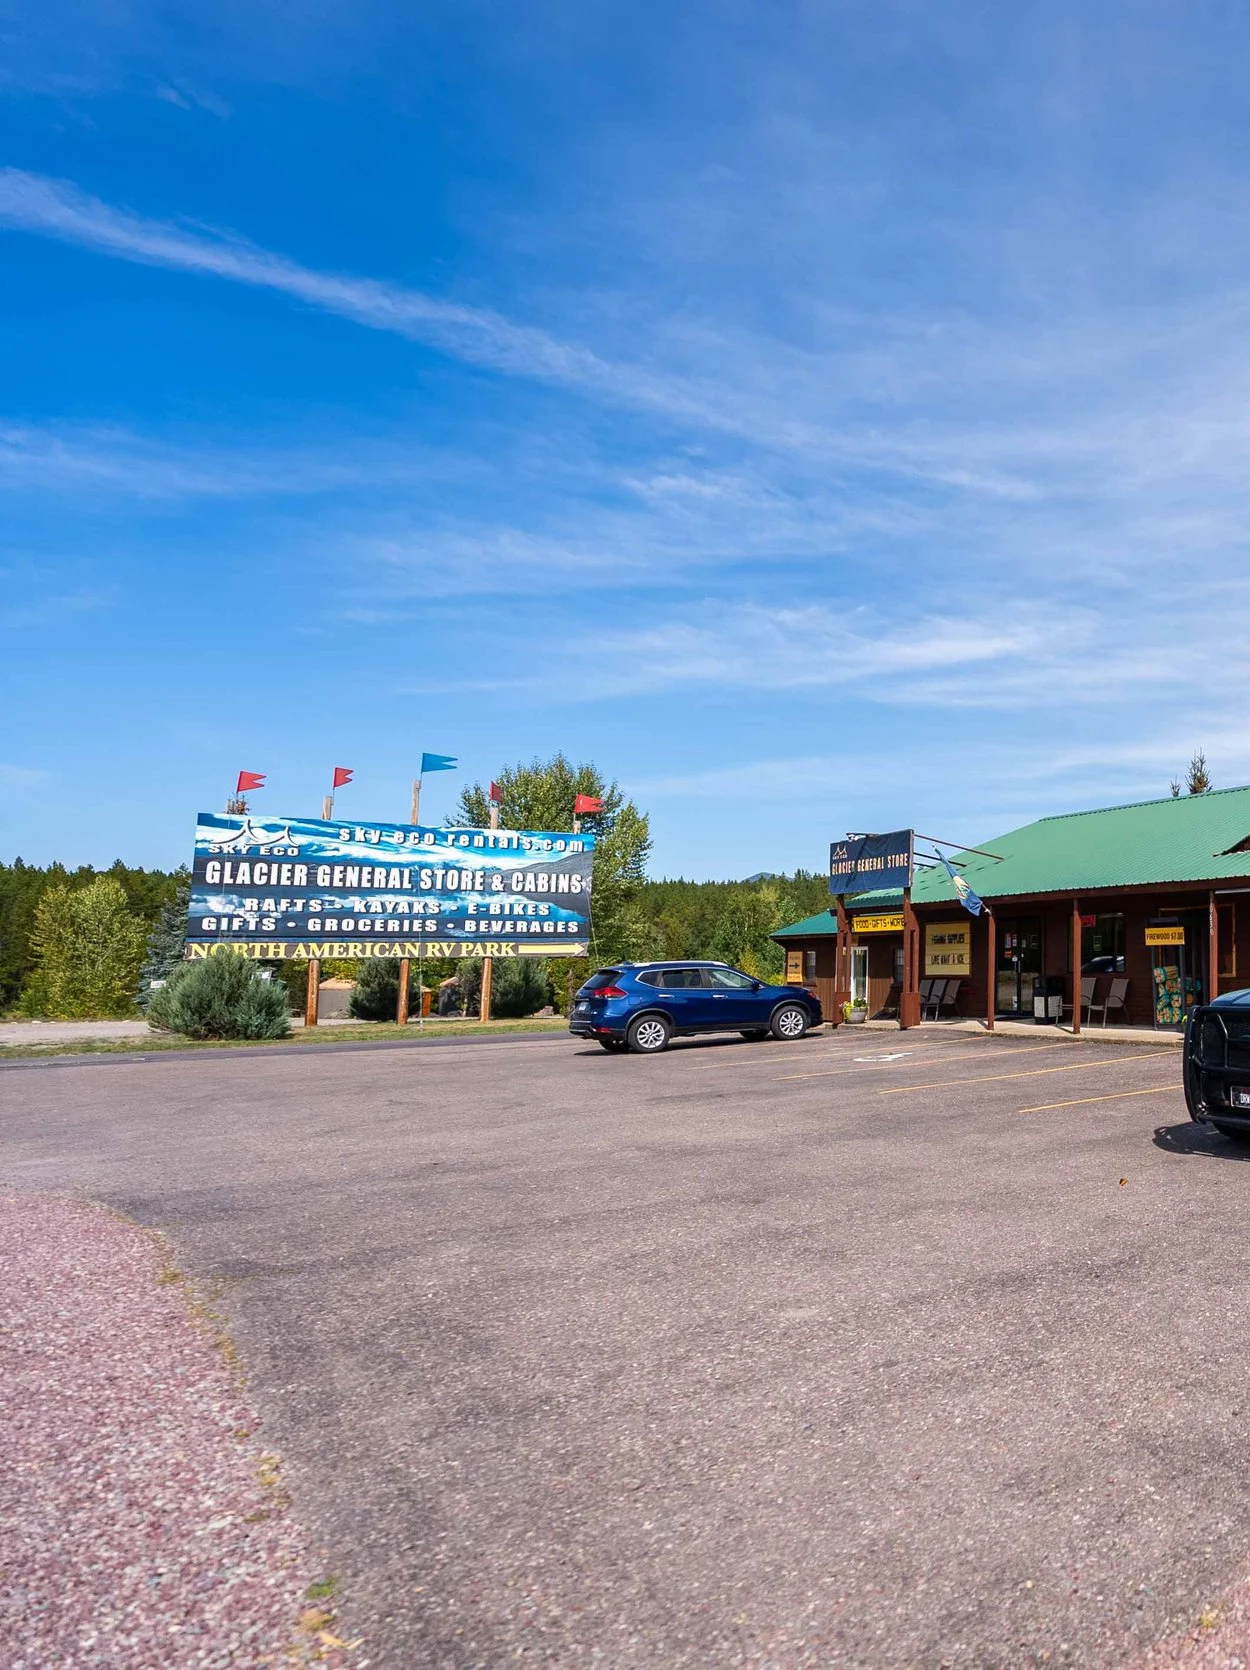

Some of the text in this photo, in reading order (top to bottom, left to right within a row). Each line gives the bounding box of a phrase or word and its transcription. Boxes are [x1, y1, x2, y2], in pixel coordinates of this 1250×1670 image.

[339, 827, 585, 853] sky eco rentals.com
[208, 844, 250, 855] SKY
[857, 856, 885, 872] GENERAL
[887, 853, 908, 868] STORE
[205, 861, 583, 894] GLACIER GENERAL STORE & CABINS
[245, 898, 550, 916] RAFTS KAYAKS E-BIKES
[201, 917, 579, 933] GIFTS GROCERIES BEVERAGES
[856, 917, 905, 928] FOOD GIFTS MORE
[1146, 932, 1170, 940] FIREWOOD
[189, 942, 516, 959] NORTH AMERICAN RV PARK
